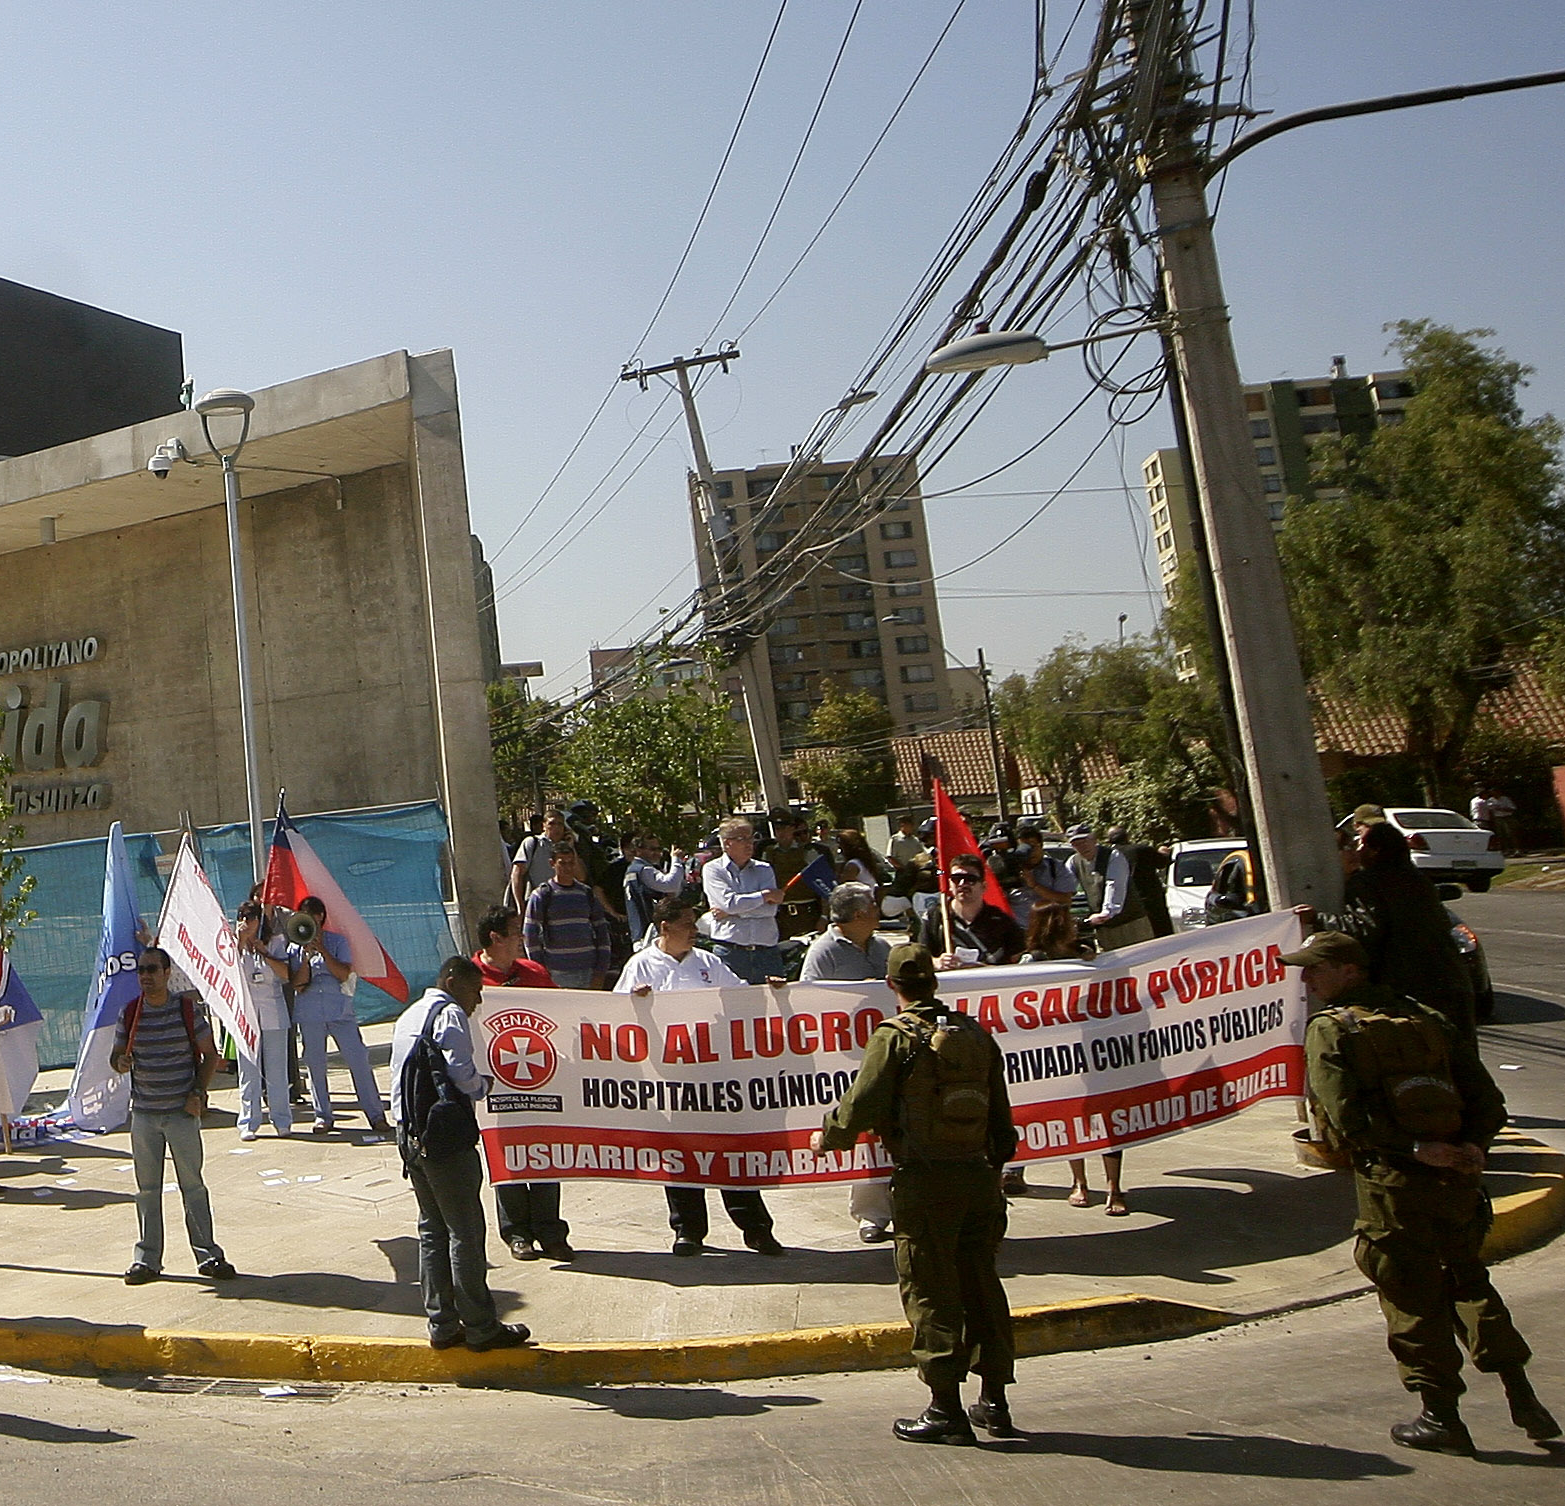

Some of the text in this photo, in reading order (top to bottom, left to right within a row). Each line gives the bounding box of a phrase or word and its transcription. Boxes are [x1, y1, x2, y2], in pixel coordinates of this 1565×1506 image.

[177, 922, 221, 992] HOSPITAL
[220, 980, 235, 1012] DEL
[491, 1014, 550, 1034] FENATS
[579, 1021, 650, 1063] NO
[662, 1022, 720, 1065] AL
[729, 1007, 884, 1061] LUCRO
[1012, 976, 1145, 1030] SALUD
[1148, 943, 1287, 1010] PÚBLICA
[581, 1077, 745, 1113] HOSPITALES
[1091, 1035, 1136, 1072] CON
[1138, 1017, 1207, 1064] FONDOS
[1210, 998, 1285, 1046] PÚBLICOS
[503, 1143, 686, 1175] USUARIOS
[691, 1149, 717, 1177] Y
[722, 1141, 895, 1178] TRABAJAD
[1072, 1112, 1108, 1145] LA
[1110, 1094, 1188, 1137] SALUD
[1190, 1086, 1219, 1117] DE
[1221, 1062, 1289, 1107] CHILE!!
